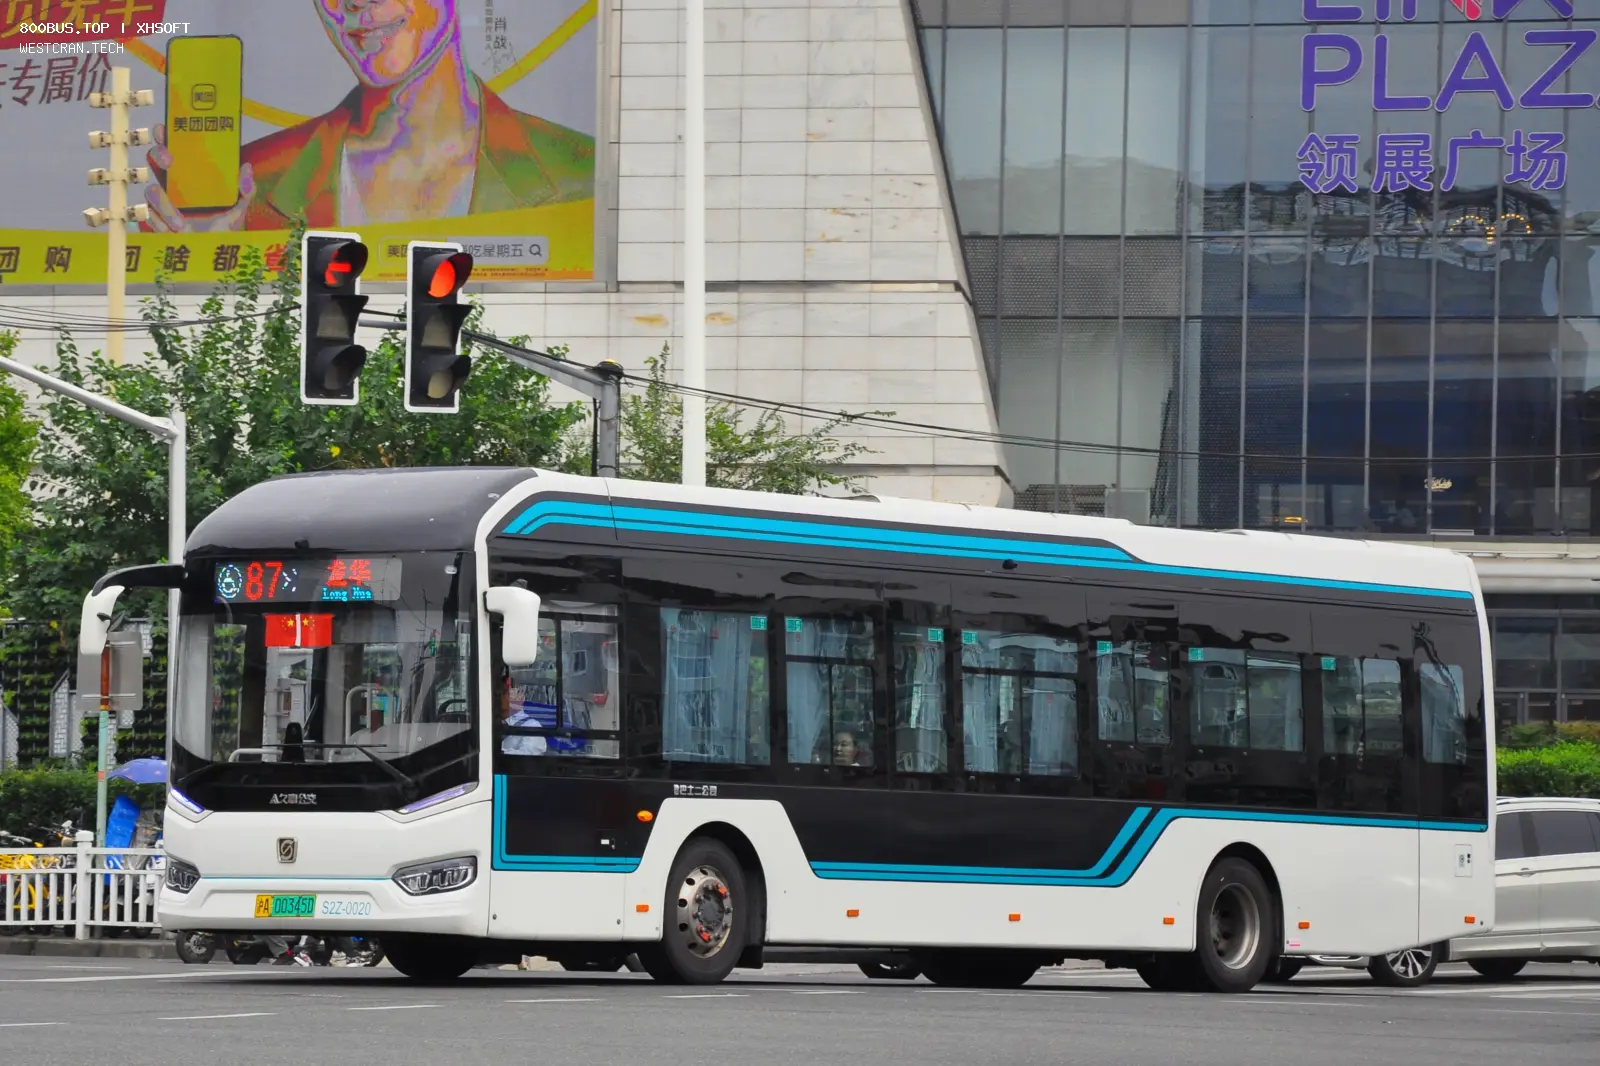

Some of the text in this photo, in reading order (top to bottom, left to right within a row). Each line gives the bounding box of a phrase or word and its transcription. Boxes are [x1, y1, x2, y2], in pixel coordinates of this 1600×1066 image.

[494, 17, 507, 49] 肖战
[1300, 30, 1600, 112] PLAZ
[173, 116, 234, 132] 美团团购
[1296, 129, 1567, 194] 领展广场
[246, 562, 283, 600] 87
[274, 898, 314, 914] 00345D
[322, 900, 371, 915] S2Z-0020
